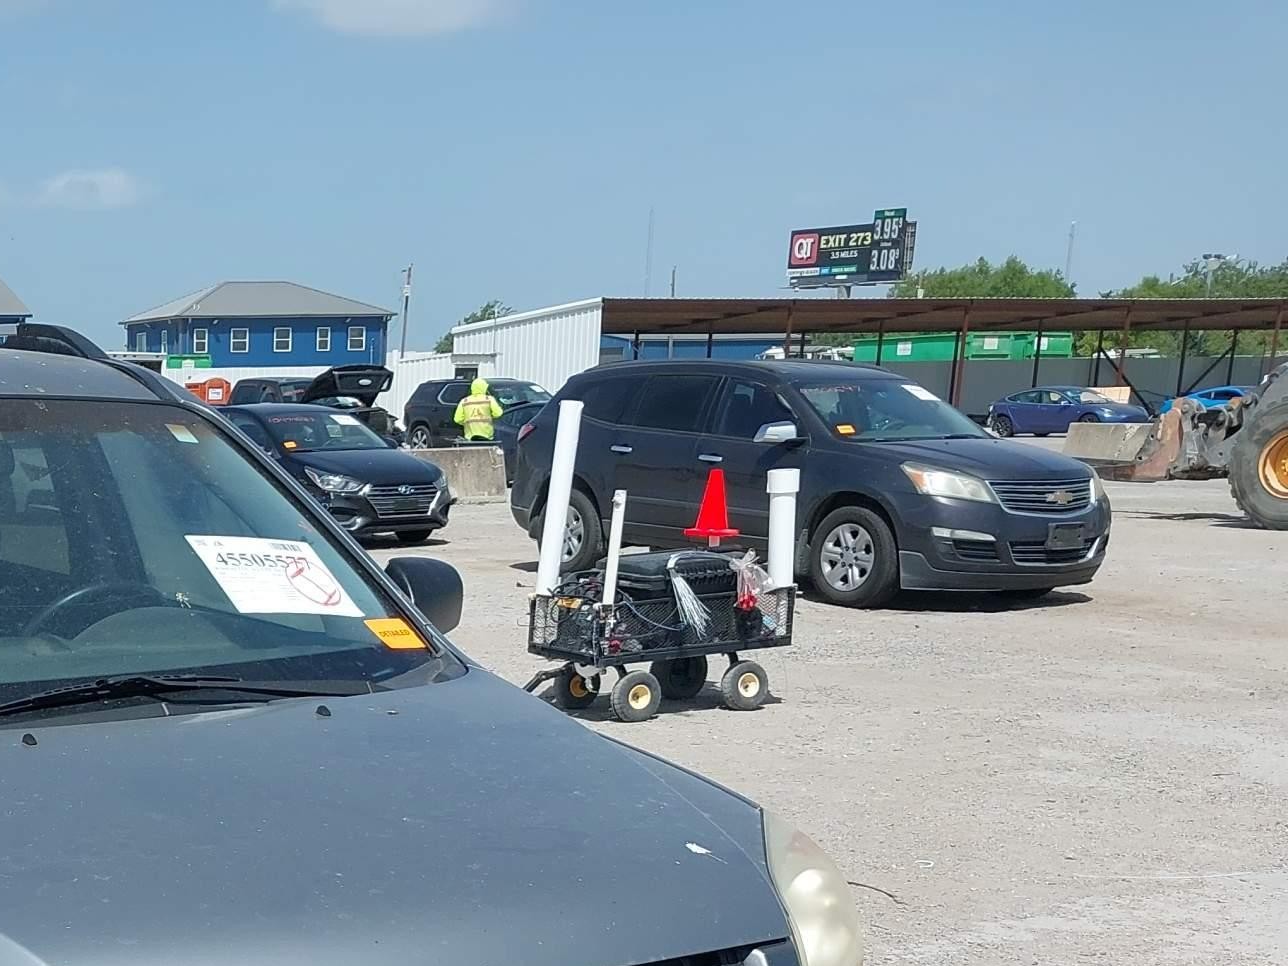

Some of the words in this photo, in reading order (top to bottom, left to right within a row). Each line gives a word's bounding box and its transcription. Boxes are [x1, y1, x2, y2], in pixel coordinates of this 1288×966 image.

[794, 238, 814, 259] QT
[820, 234, 847, 248] EXIT
[849, 232, 872, 246] 273
[840, 250, 858, 258] MILES
[215, 552, 311, 570] 45505577
